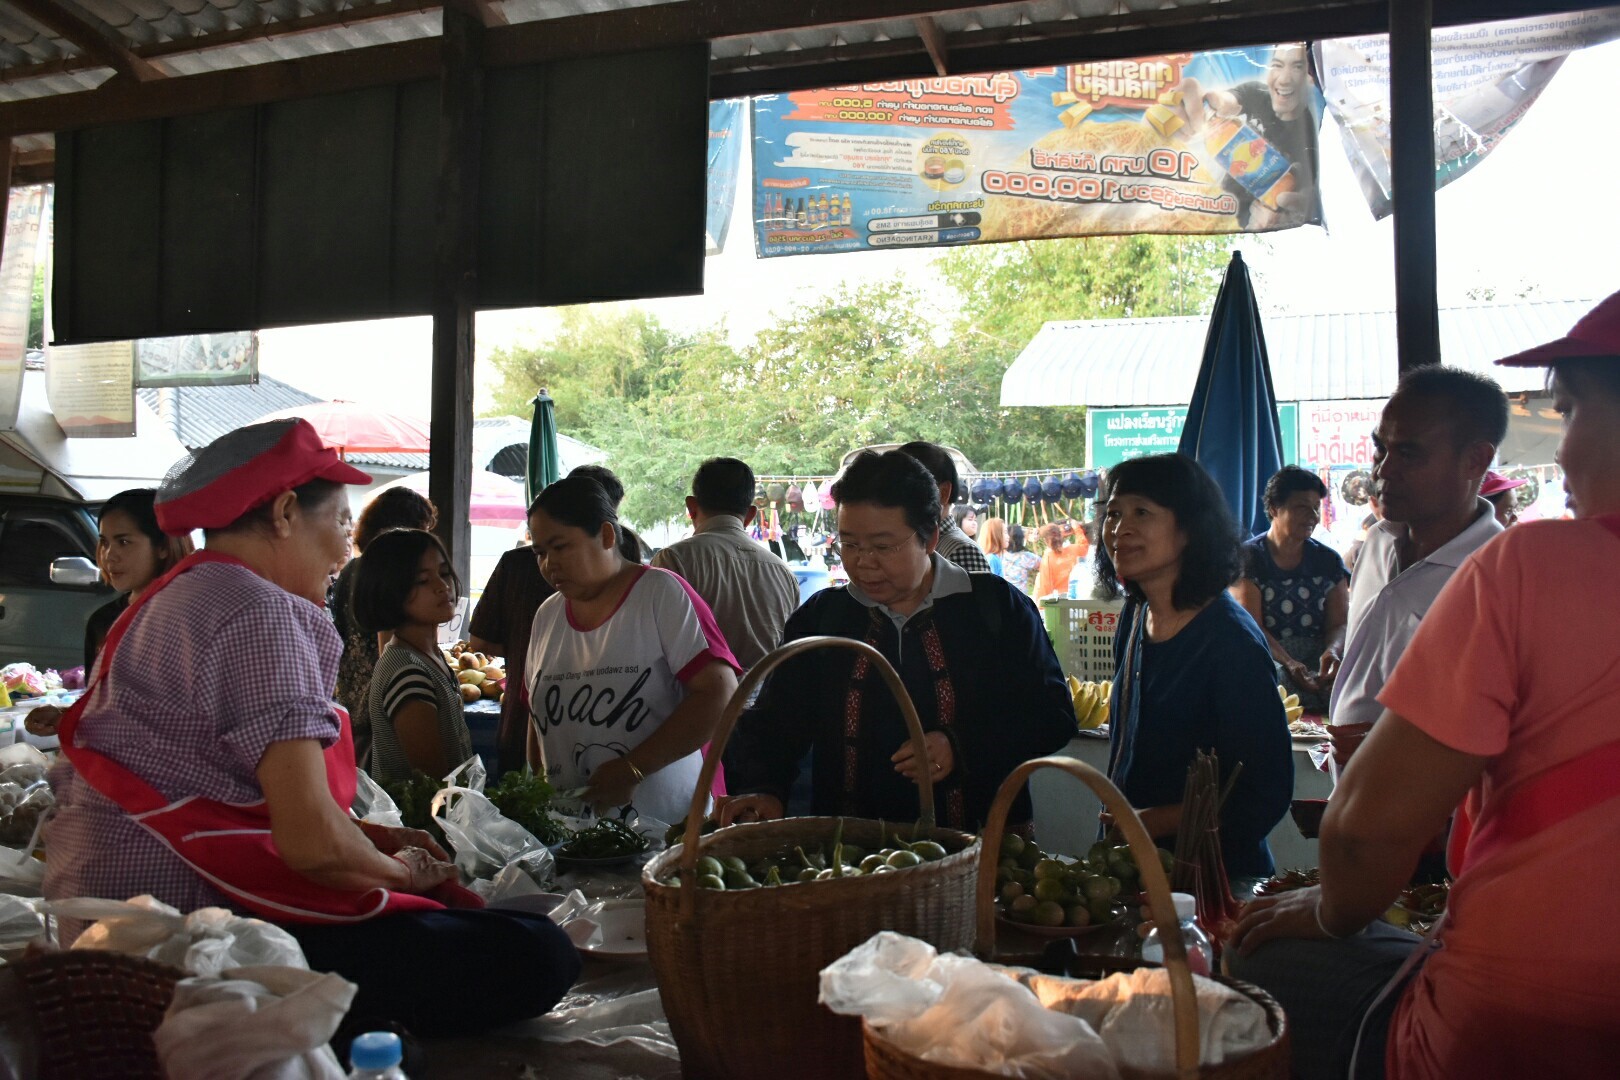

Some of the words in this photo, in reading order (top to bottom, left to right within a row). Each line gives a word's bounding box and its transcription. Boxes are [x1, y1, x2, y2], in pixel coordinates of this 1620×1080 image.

[1106, 410, 1186, 434] แปลงเรียนรู้กา
